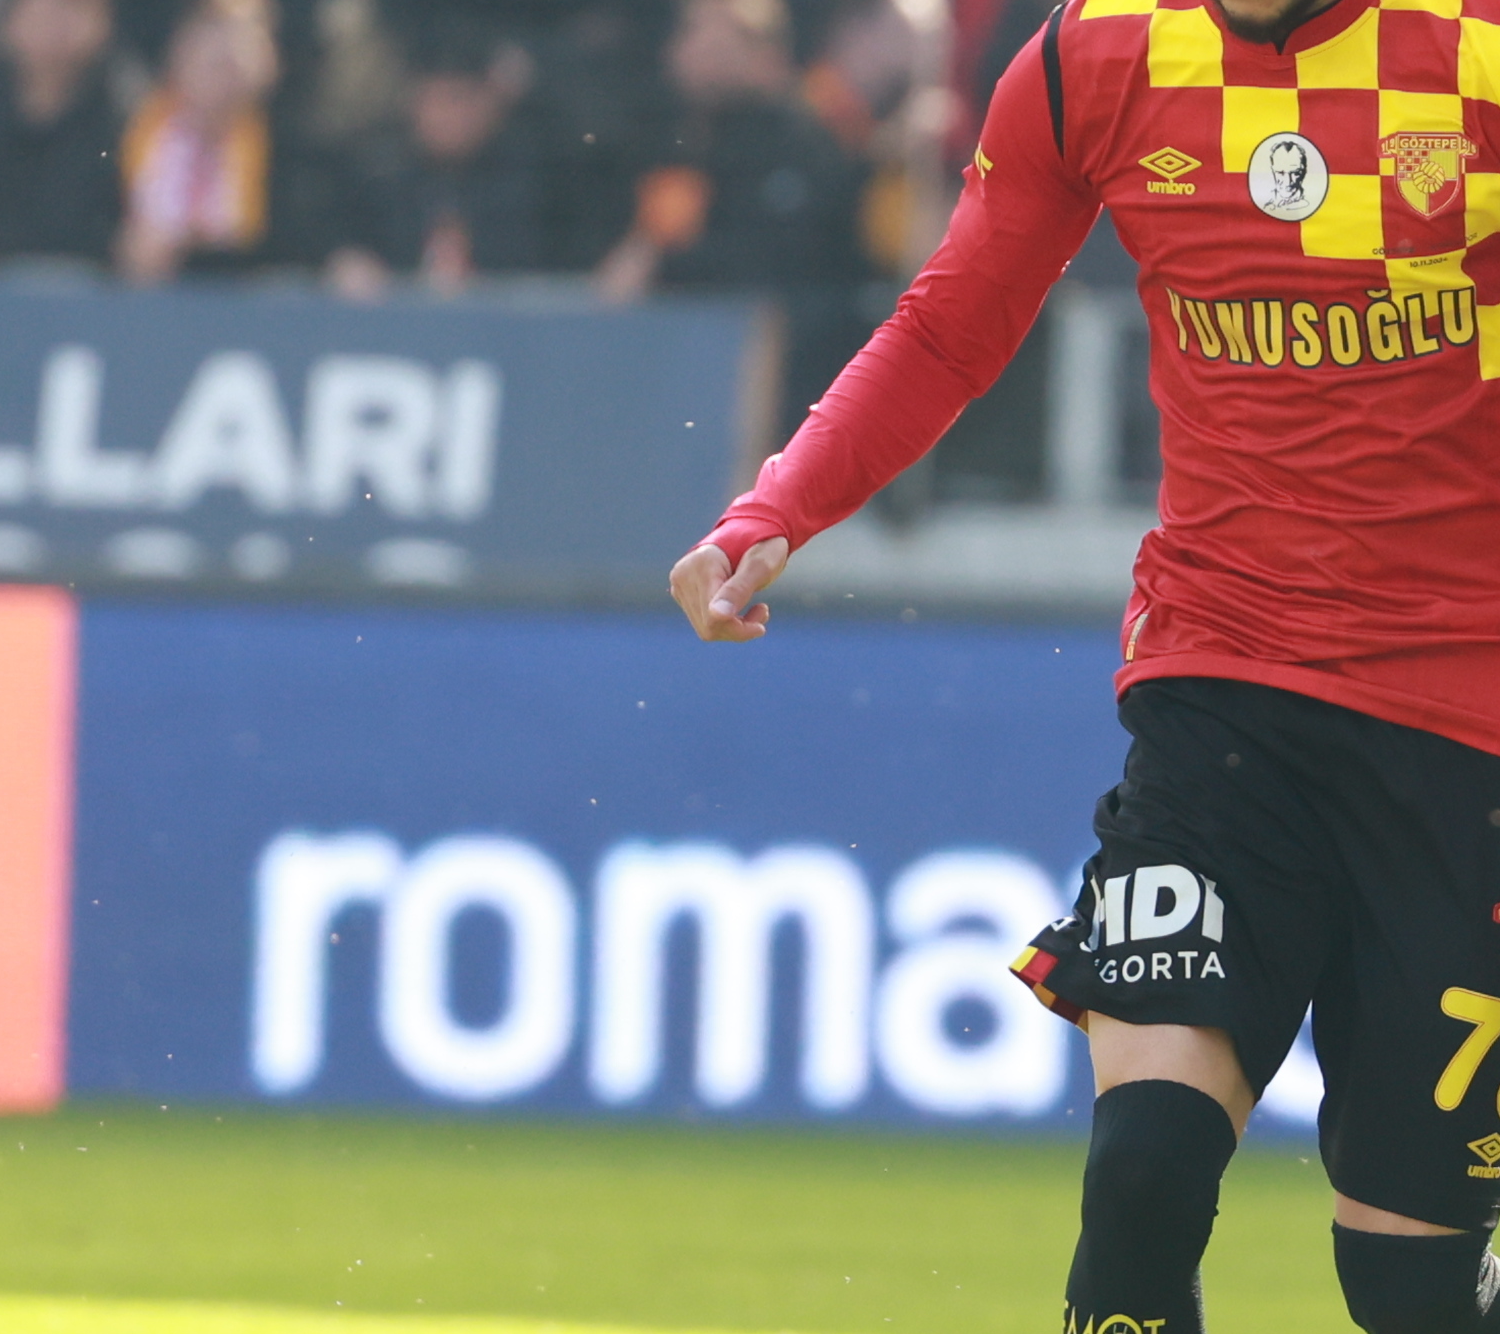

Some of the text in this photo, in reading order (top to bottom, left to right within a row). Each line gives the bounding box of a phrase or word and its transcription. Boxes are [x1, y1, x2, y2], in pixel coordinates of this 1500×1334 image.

[1400, 136, 1458, 149] GÖZTEPE
[1147, 179, 1196, 196] umbro
[1165, 286, 1476, 368] YUNUSOĞLU
[1094, 950, 1226, 984] GORTA
